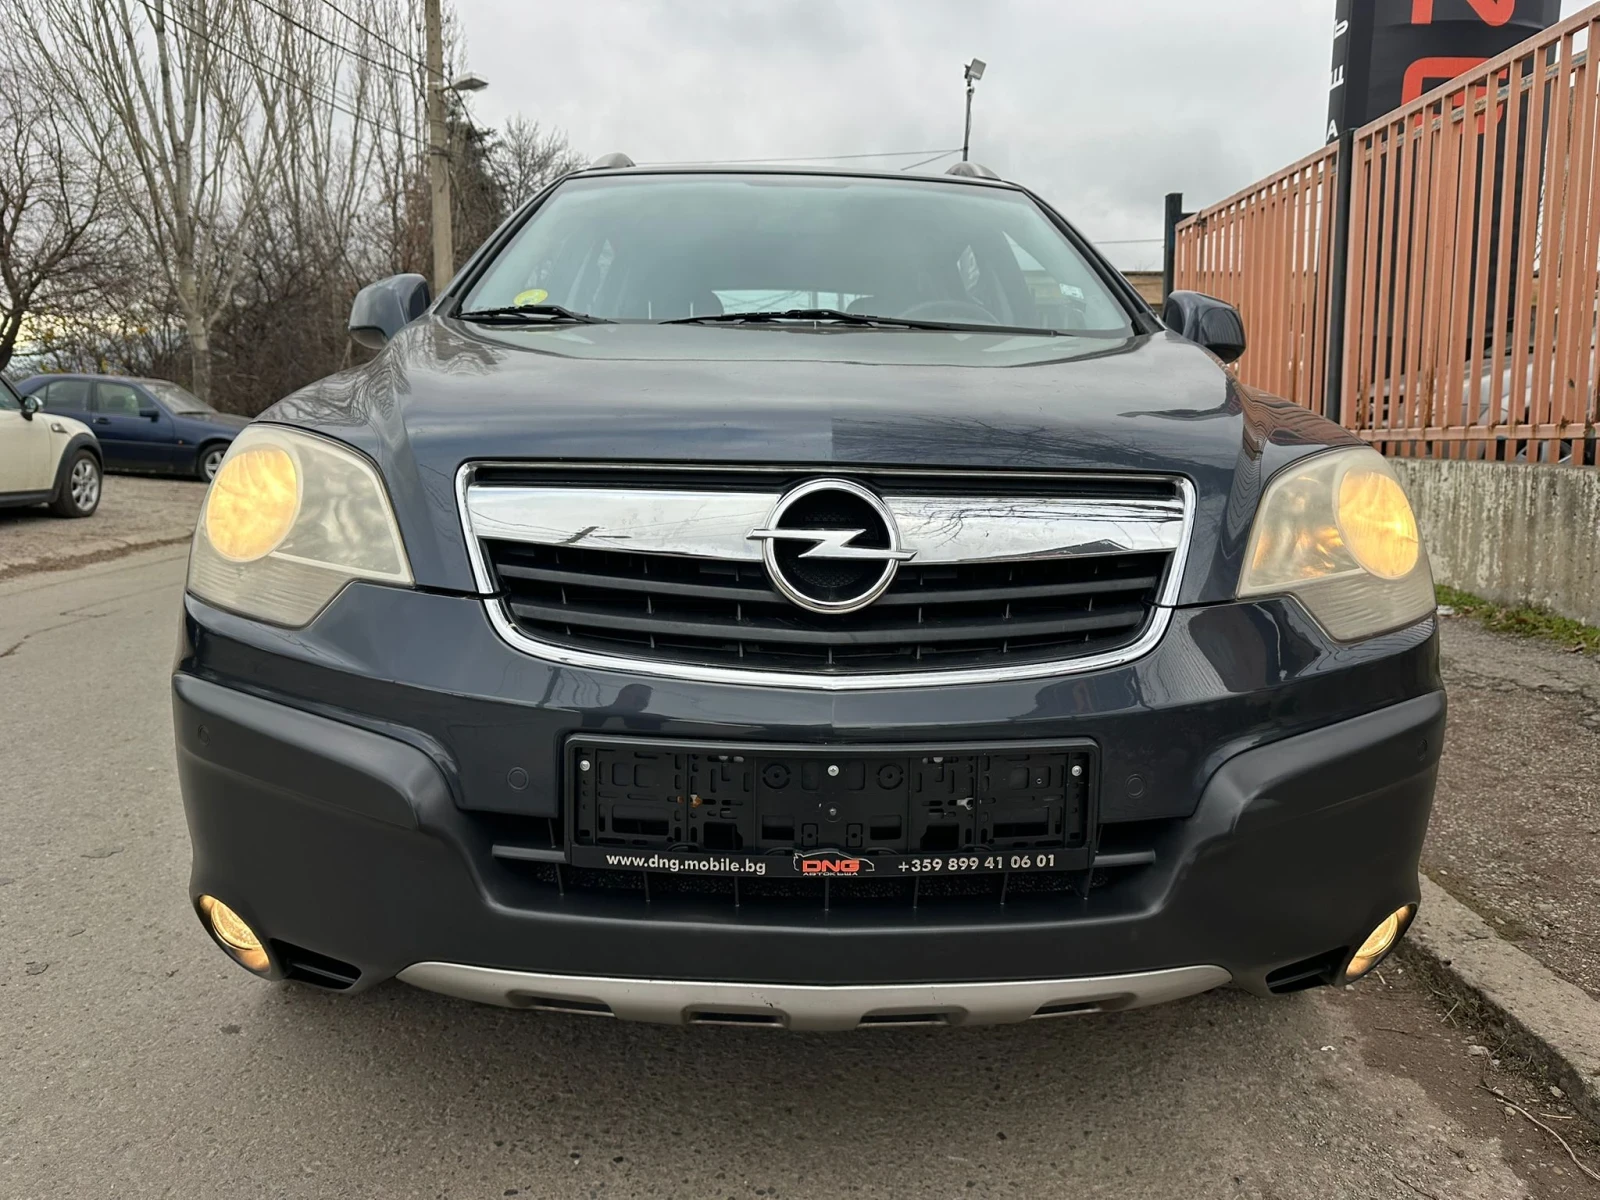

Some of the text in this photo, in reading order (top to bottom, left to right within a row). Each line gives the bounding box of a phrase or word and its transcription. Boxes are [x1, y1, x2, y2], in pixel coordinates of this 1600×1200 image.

[606, 854, 766, 875] www.dng.mobile.bg
[803, 859, 860, 872] DNG
[898, 854, 1055, 872] +359 899 41 06 01
